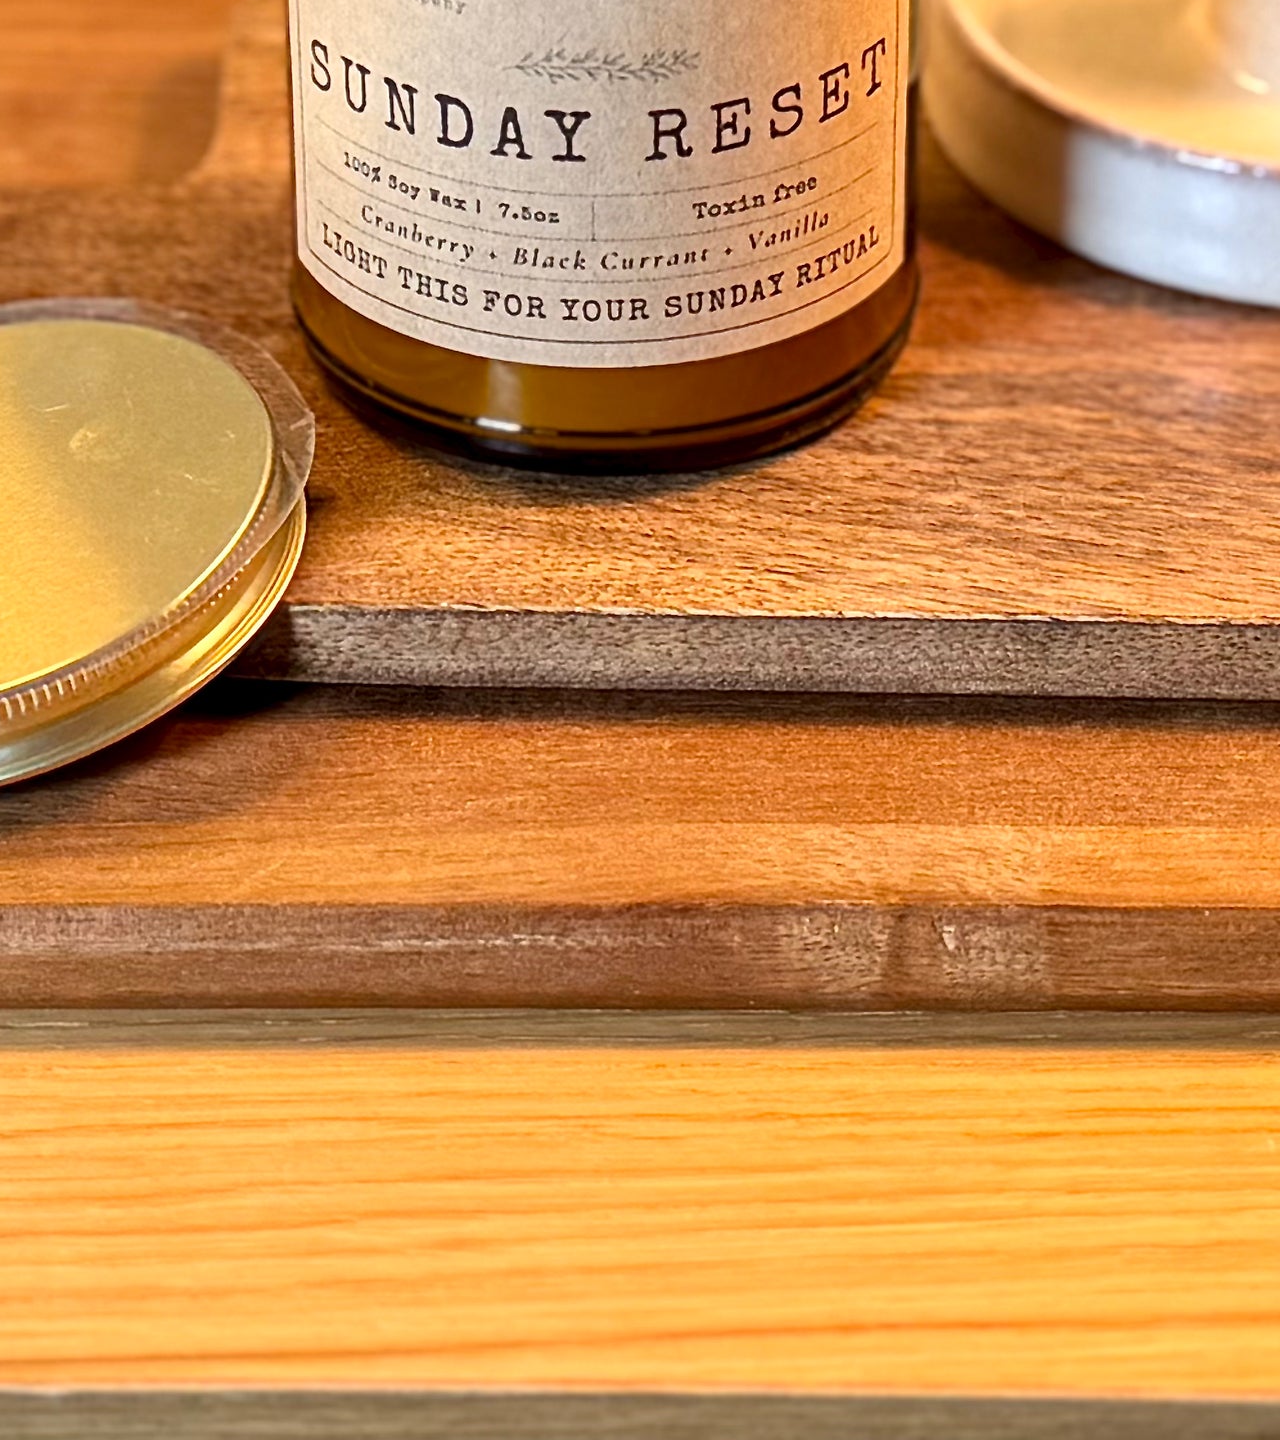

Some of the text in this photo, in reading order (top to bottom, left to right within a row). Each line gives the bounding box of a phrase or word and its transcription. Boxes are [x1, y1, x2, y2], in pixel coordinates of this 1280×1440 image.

[310, 37, 887, 163] SUNDAY RESET
[343, 151, 381, 183] 100%
[388, 174, 420, 200] Soy
[429, 187, 467, 211] Wax
[498, 202, 560, 224] 7.5oz
[692, 176, 818, 220] Toxin free
[321, 222, 880, 322] LIGHT THIS FOR YOUR SUNDAY RITUAL
[361, 205, 829, 271] Cranberry Black Currant Vanilla
